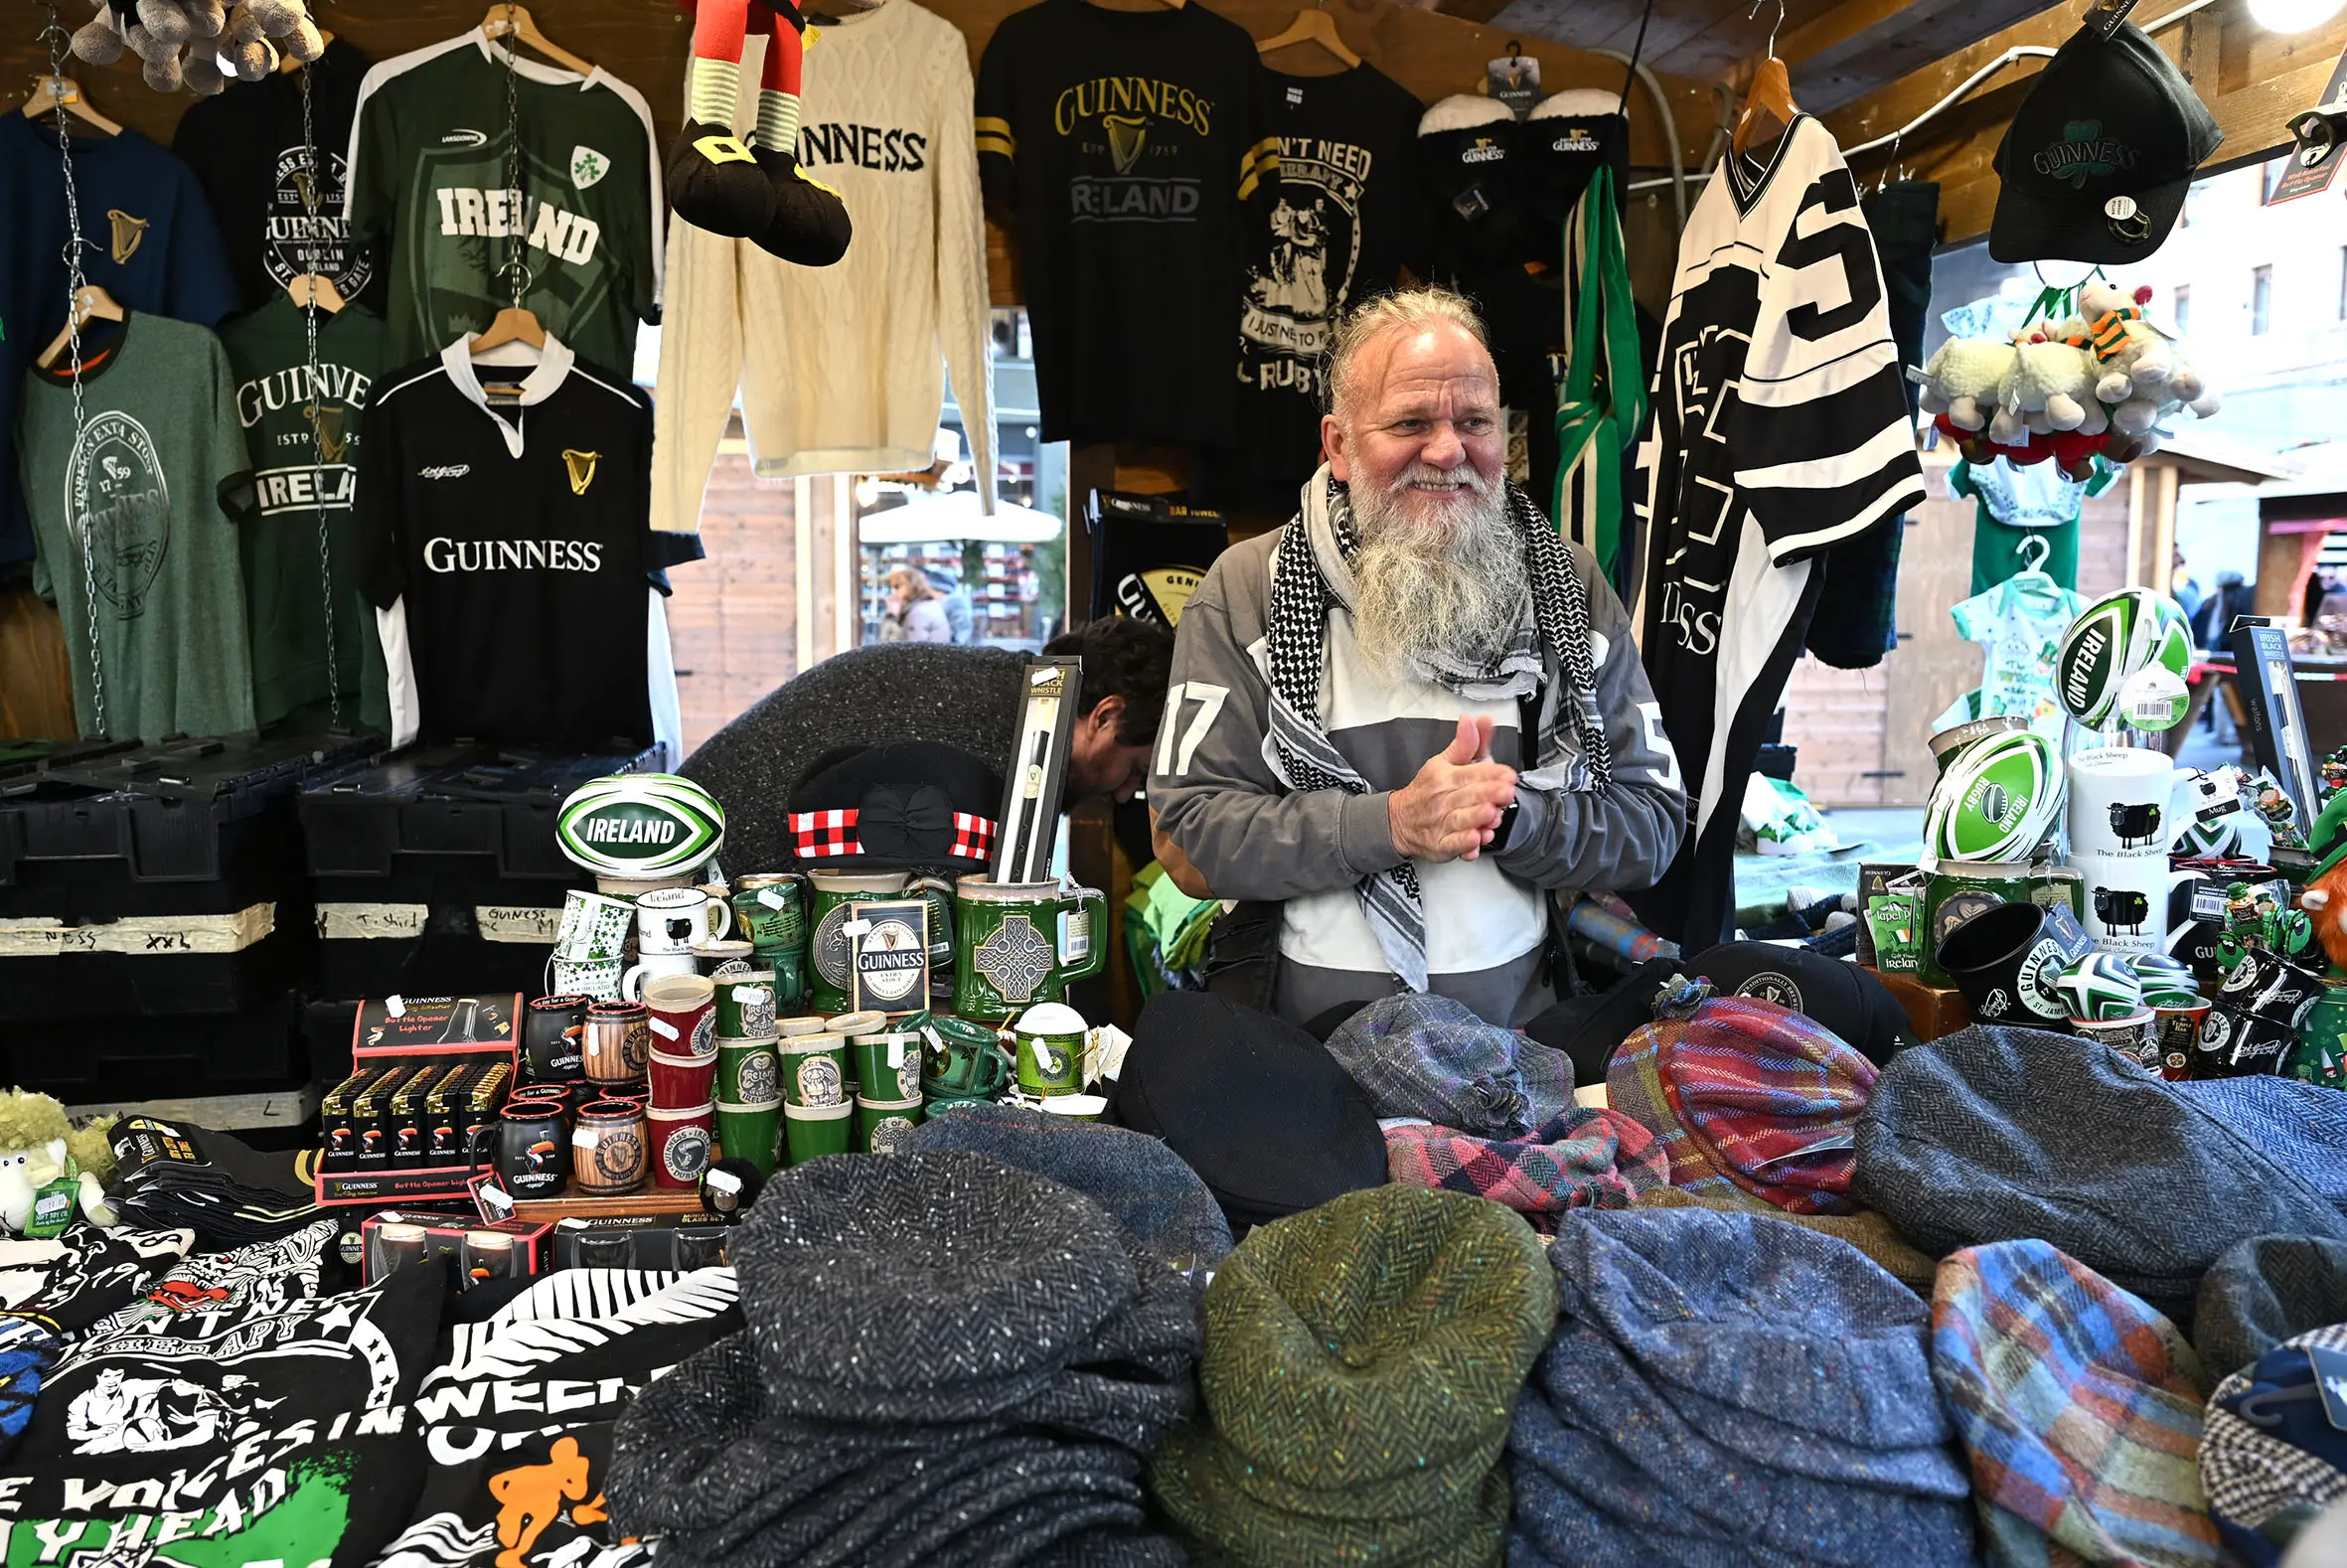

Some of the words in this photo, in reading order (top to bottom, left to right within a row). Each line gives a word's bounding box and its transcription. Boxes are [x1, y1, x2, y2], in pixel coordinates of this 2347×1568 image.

[1055, 77, 1210, 136] GUINNESS
[795, 123, 926, 173] NNESS
[1552, 140, 1600, 151] GUINNESS
[1318, 140, 1372, 182] NEED
[1463, 150, 1504, 163] GUINNESS
[2033, 142, 2140, 175] GUINNESS
[1170, 506, 1187, 517] BAR
[423, 537, 602, 573] GUINNESS
[2259, 633, 2281, 643] IRISH
[2261, 642, 2283, 651] BLACK
[2264, 650, 2285, 659] WHISTLE
[2067, 627, 2107, 708] IRELAND
[2250, 698, 2263, 732] waltons
[1157, 681, 1230, 776] 17
[1635, 702, 1681, 791] 5
[2087, 752, 2104, 761] Black
[2105, 751, 2128, 760] Sheep
[1963, 775, 1990, 813] RUGBY
[1998, 794, 2029, 834] IRELAND
[2208, 805, 2227, 815] Mug
[586, 818, 676, 845] IRELAND
[2096, 849, 2113, 858] The
[2116, 850, 2142, 859] Black
[2144, 848, 2164, 858] Sheep
[1905, 911, 1921, 920] Pn
[2102, 938, 2128, 948] Black
[2131, 938, 2155, 949] Sheep
[858, 951, 925, 971] GUINNESS
[2040, 987, 2051, 997] 17
[417, 1015, 449, 1023] Opener
[398, 1024, 433, 1033] Lighter
[742, 1093, 775, 1104] IRELAND
[665, 1131, 688, 1173] GUINNESS
[513, 1173, 555, 1184] GUINNESS
[673, 1167, 704, 1181] DUBLIN
[342, 1181, 379, 1190] GUINNESS
[394, 1179, 421, 1189] Bottle
[422, 1179, 449, 1188] Opener
[587, 1216, 654, 1226] GUINNESS
[103, 1467, 287, 1552] HEAD
